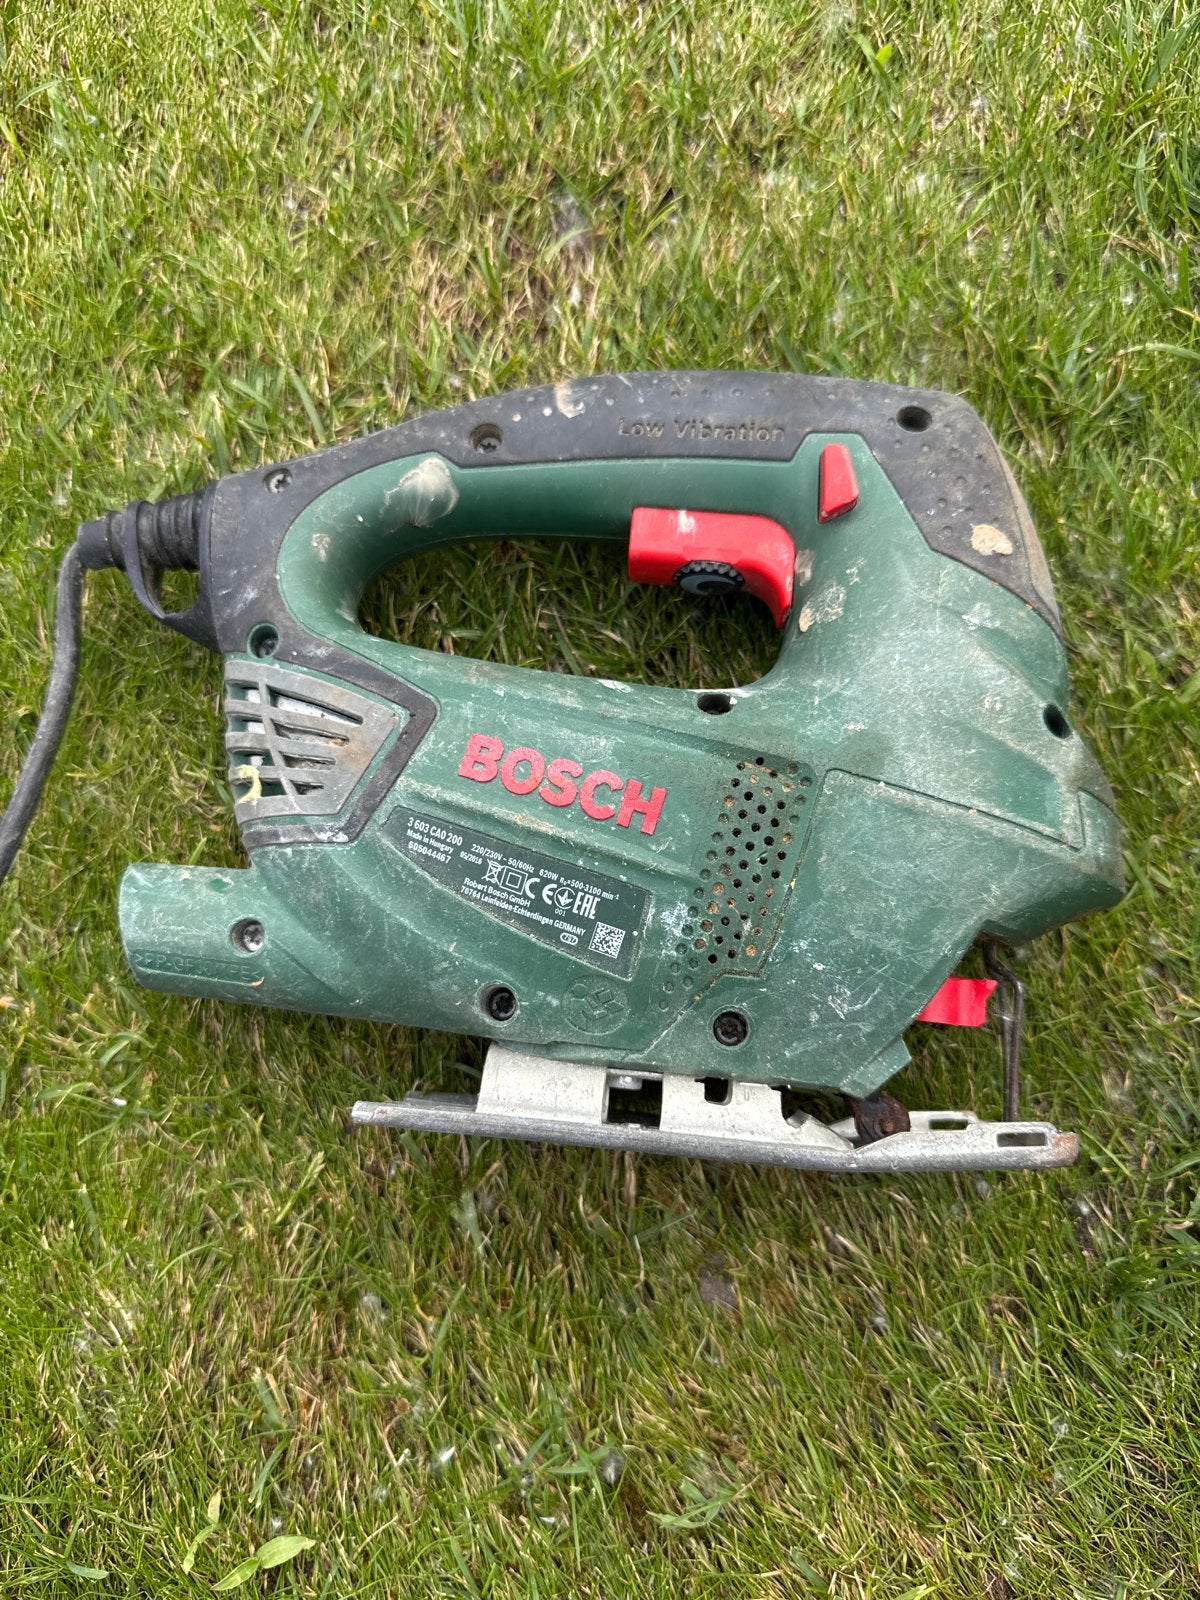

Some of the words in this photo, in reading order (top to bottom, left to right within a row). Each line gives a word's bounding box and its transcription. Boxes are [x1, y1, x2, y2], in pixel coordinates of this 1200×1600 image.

[617, 417, 665, 438] Low
[673, 418, 786, 442] Vibration
[458, 733, 667, 836] BOSCH
[406, 829, 423, 841] Made
[422, 833, 429, 843] in
[429, 837, 454, 854] Hungary
[407, 817, 414, 827] 3
[414, 819, 430, 833] 603
[446, 832, 463, 846] 200
[408, 840, 452, 864] 605044467
[470, 843, 503, 861] 220/230V
[507, 857, 535, 873] 50/60Hz
[539, 868, 559, 881] 620W
[463, 877, 488, 892] Robert
[487, 885, 509, 900] Bosch
[508, 893, 531, 908] GmbH
[460, 885, 481, 900] 70764
[481, 892, 554, 926] Leinfelden-Echterdingen
[553, 919, 587, 937] GERMANY
